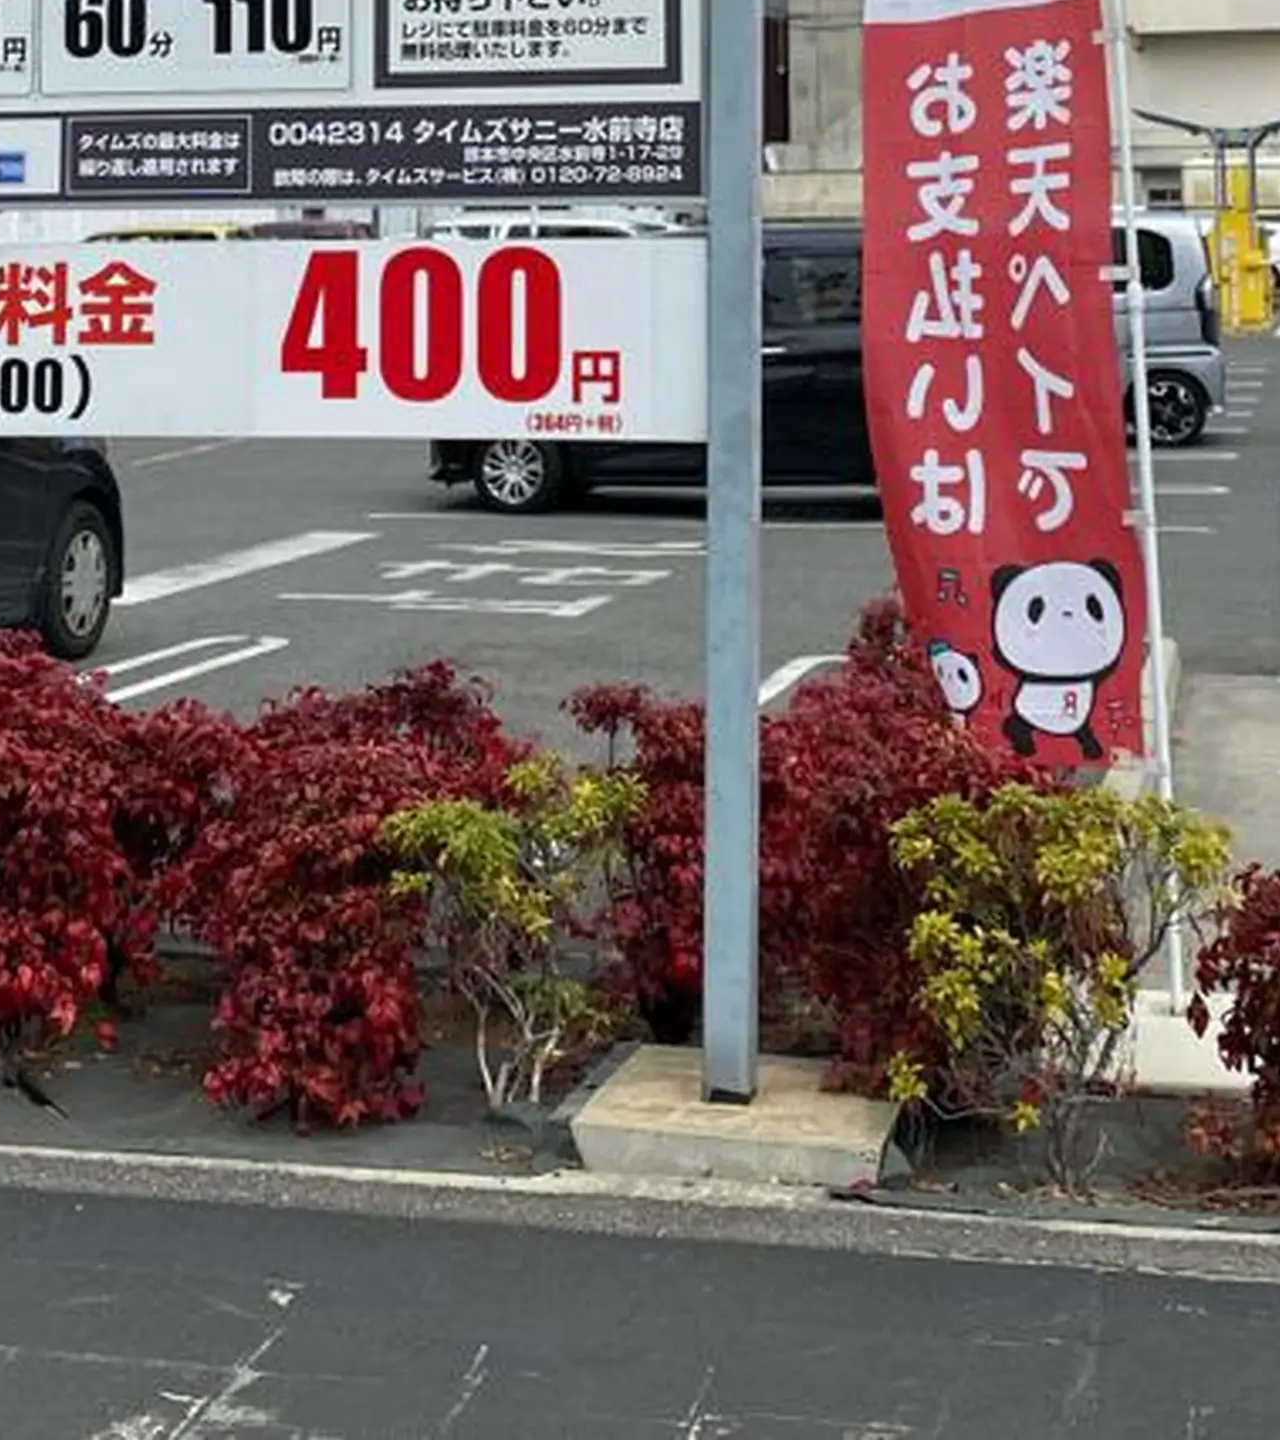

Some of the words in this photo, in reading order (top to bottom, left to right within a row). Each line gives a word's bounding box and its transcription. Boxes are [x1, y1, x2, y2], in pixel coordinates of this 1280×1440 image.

[269, 120, 405, 146] 0042314
[413, 115, 685, 144] タイムズサニー水前寺店
